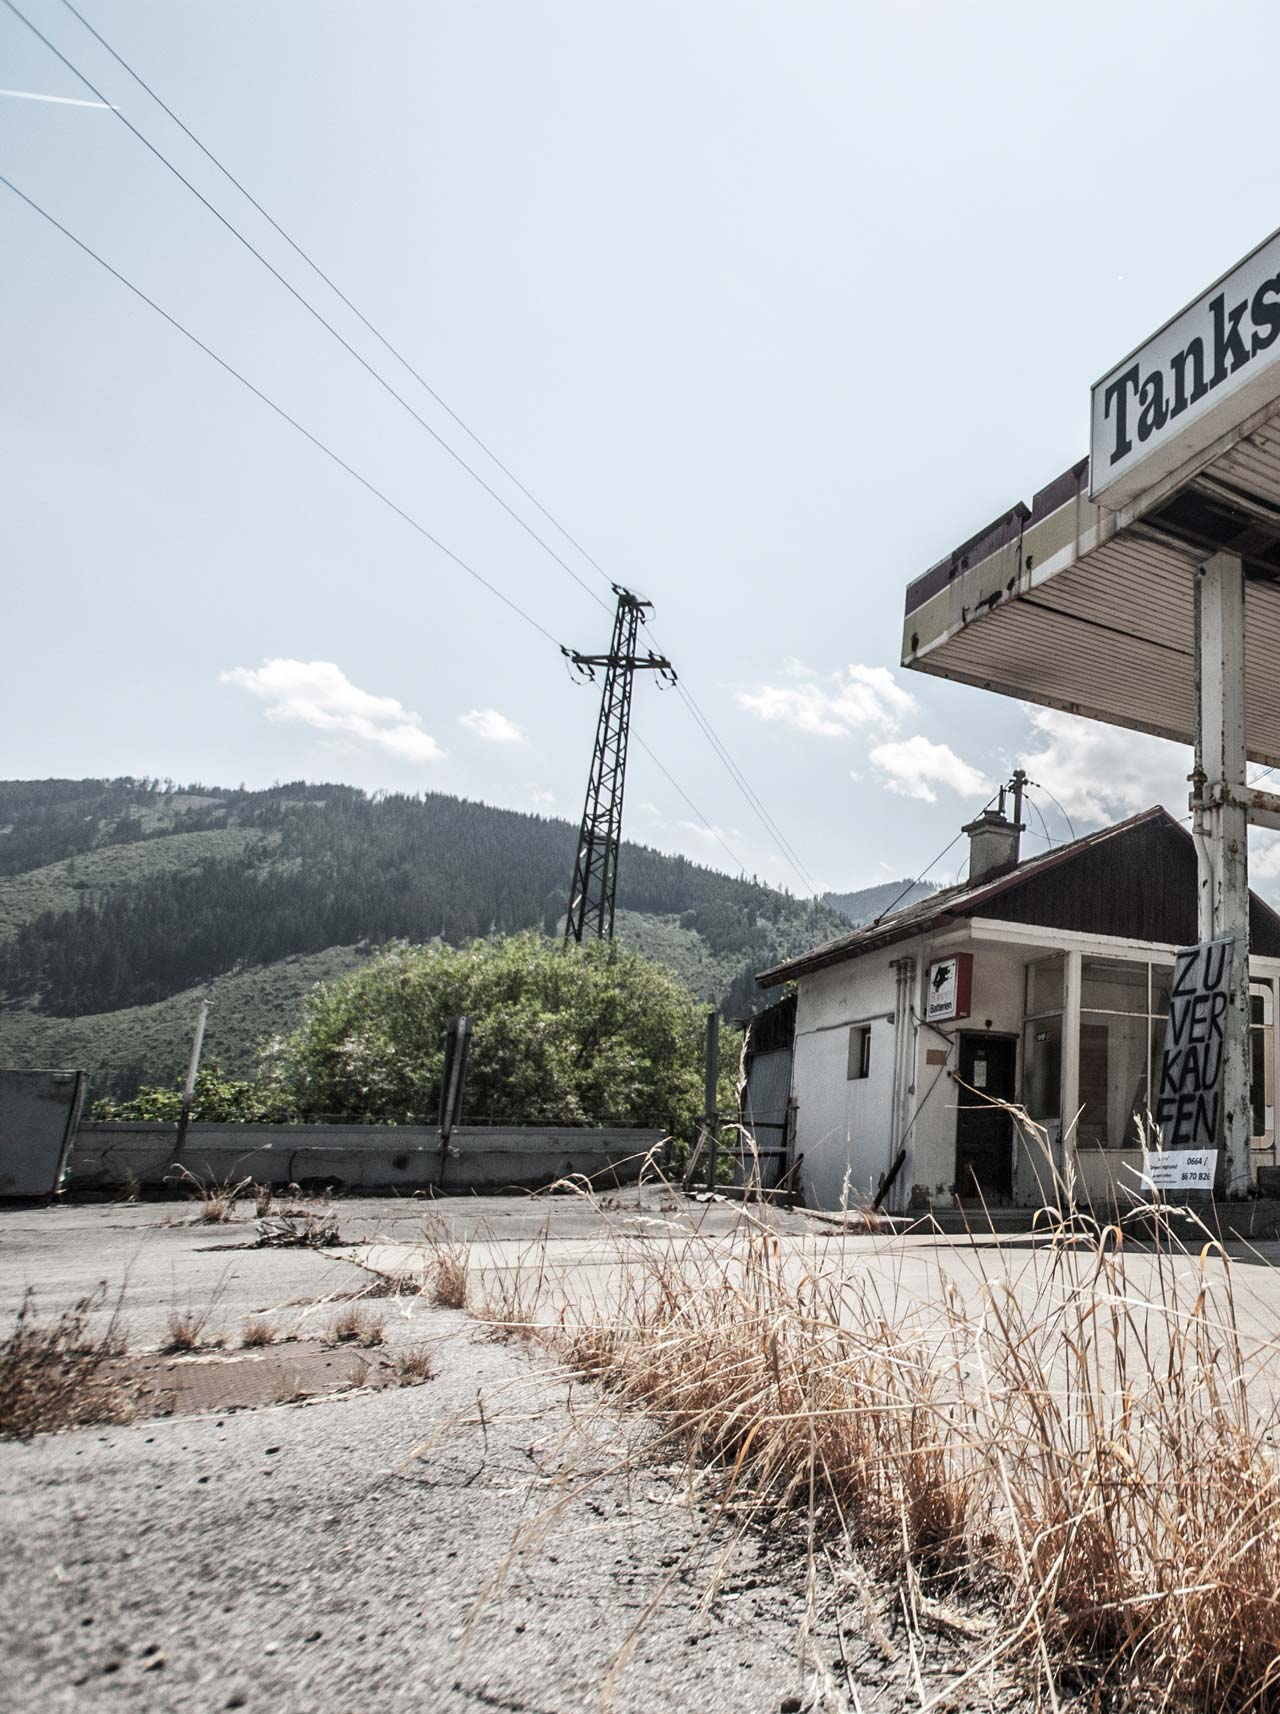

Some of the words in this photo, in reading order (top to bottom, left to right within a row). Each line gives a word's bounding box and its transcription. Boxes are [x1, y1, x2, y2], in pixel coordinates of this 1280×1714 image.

[1172, 943, 1226, 997] ZU
[1170, 991, 1227, 1046] VER
[1160, 1041, 1223, 1094] KAU
[1156, 1092, 1218, 1144] FEN
[1187, 1157, 1202, 1166] 0664
